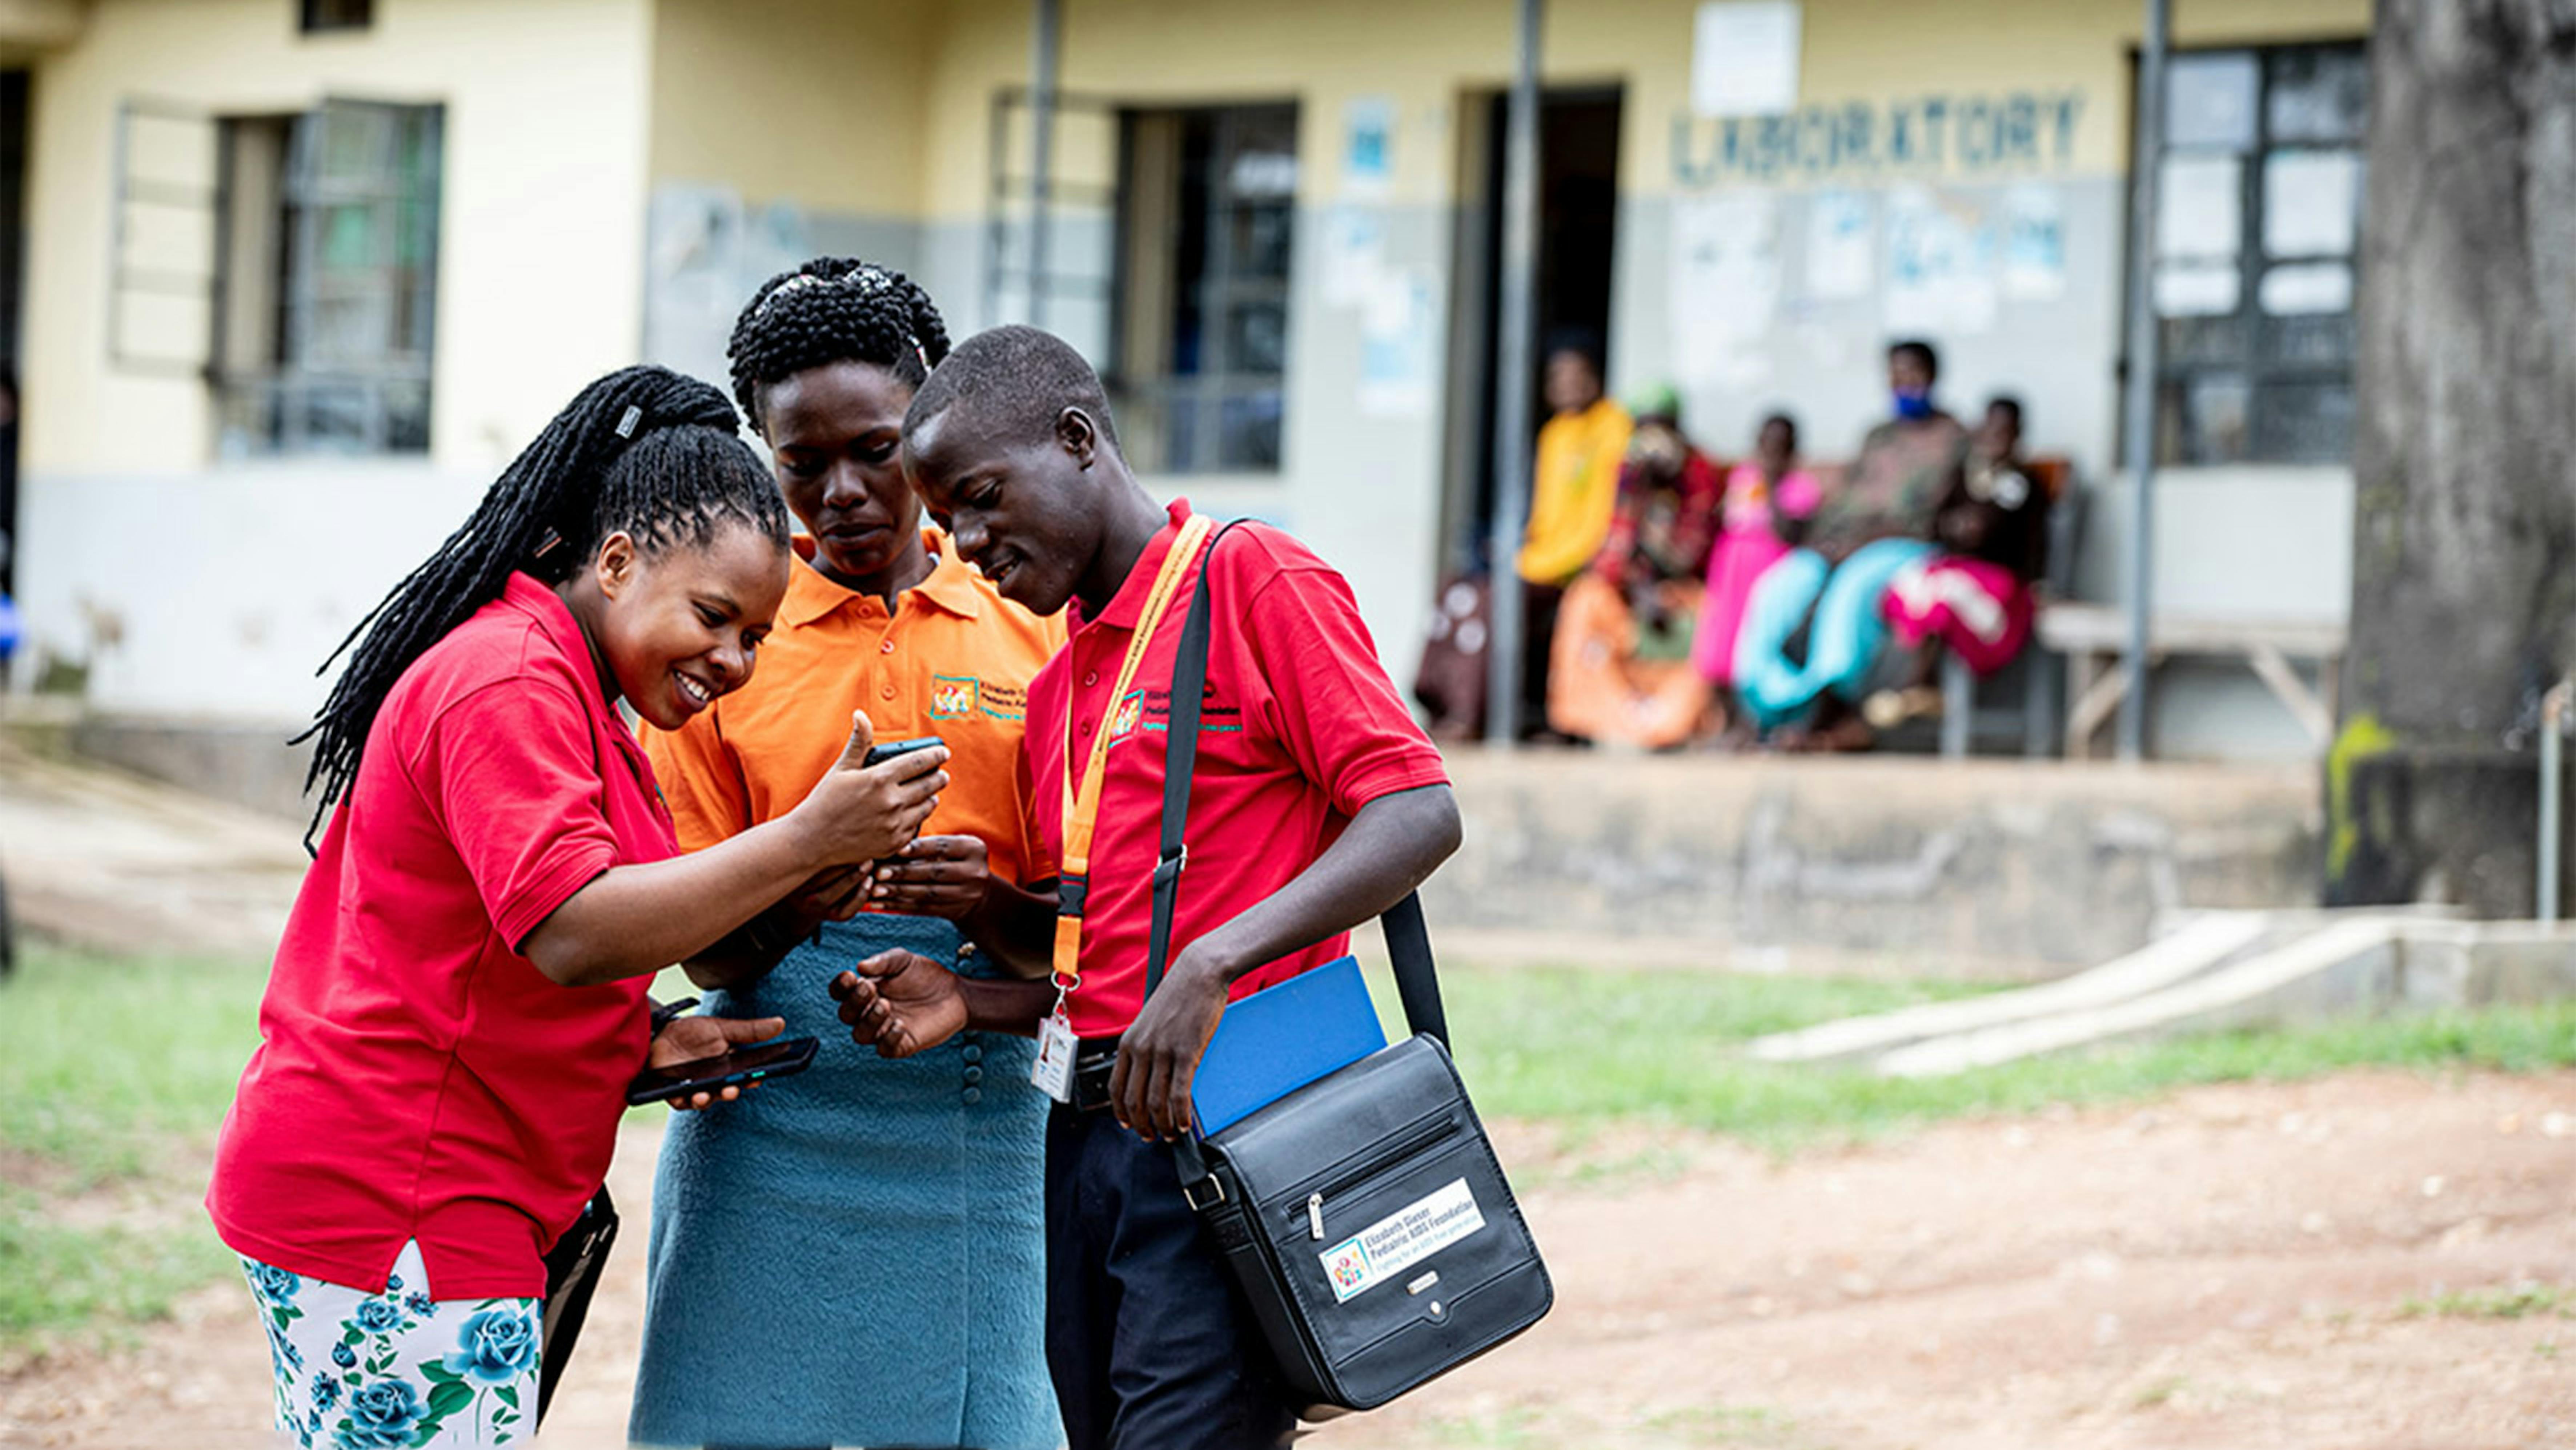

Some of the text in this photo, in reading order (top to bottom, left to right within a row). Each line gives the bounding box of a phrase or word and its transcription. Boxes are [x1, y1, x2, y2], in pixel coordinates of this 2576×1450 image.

[1669, 89, 2085, 185] LABORATORY
[1365, 1208, 1431, 1247] Elizabeth Glaser
[1370, 1199, 1473, 1260] Pediatric AIDS Foundation
